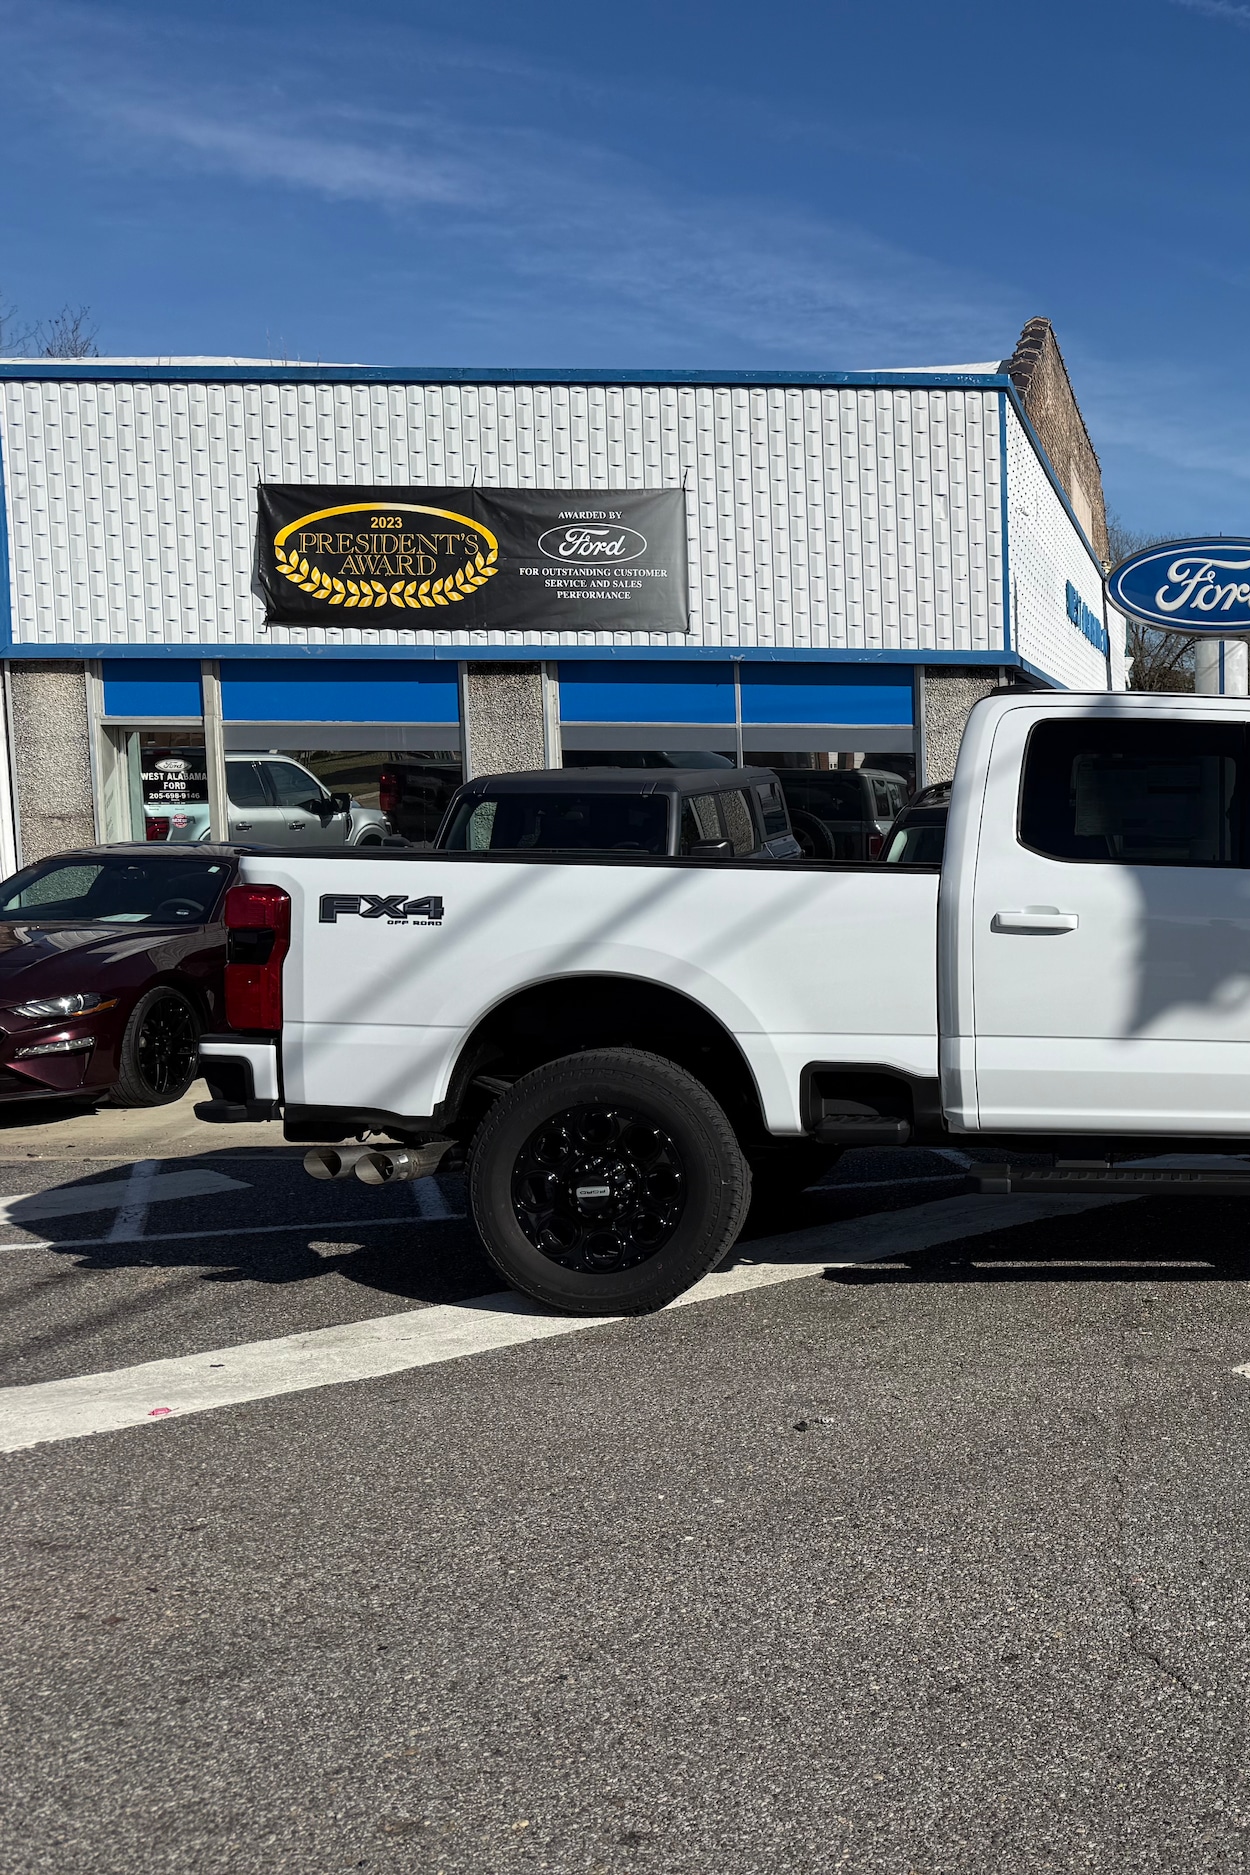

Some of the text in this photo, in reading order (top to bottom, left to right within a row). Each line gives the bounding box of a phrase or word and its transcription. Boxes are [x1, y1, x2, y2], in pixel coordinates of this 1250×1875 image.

[558, 511, 623, 519] AWARDED BY
[370, 516, 403, 529] 2023
[298, 532, 480, 556] PRESIDENT'S
[558, 528, 626, 556] Ford
[337, 554, 437, 576] AWARD
[519, 567, 668, 578] FOR OUTSTANDING CUSTOMER
[544, 579, 643, 589] SERVICE AND SALES
[557, 591, 631, 600] PERFORMANCE
[140, 772, 207, 781] WEST ALABAMA
[163, 781, 186, 790] FORD
[149, 792, 200, 800] 205-698-9146
[319, 893, 445, 924] FX4
